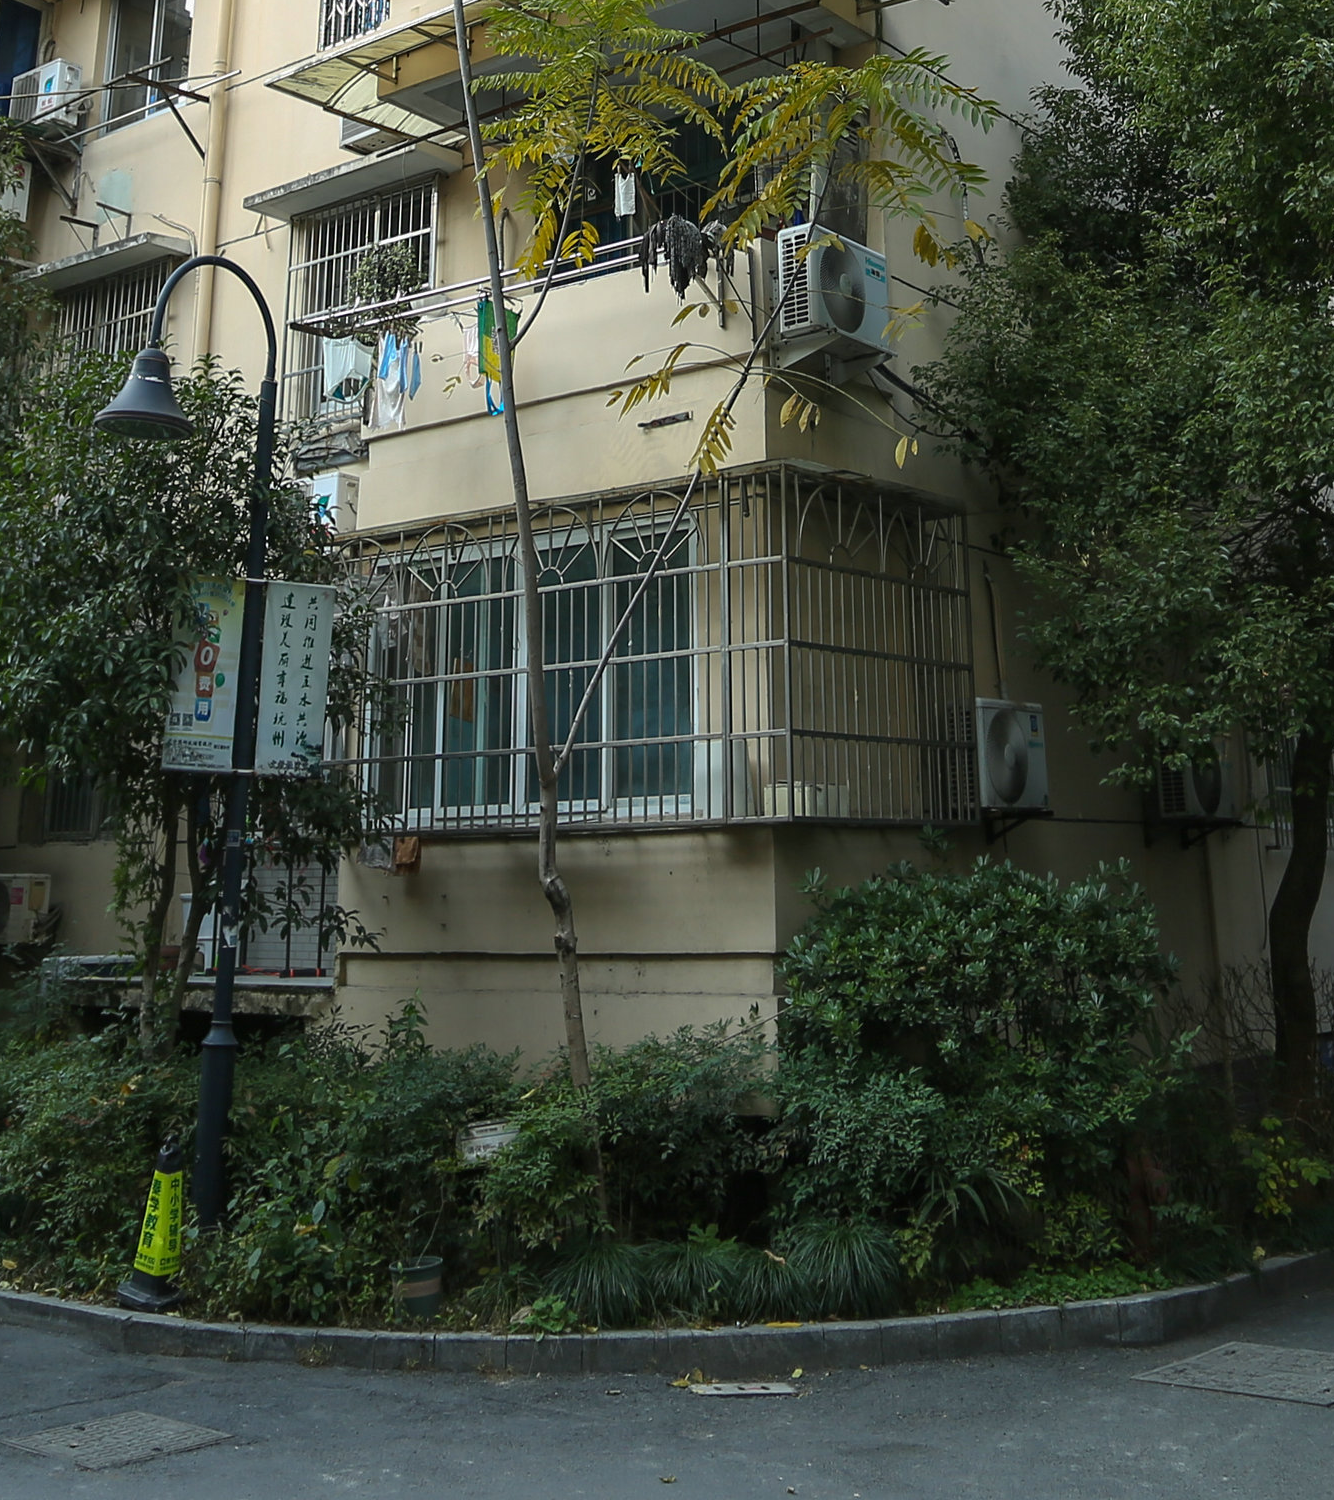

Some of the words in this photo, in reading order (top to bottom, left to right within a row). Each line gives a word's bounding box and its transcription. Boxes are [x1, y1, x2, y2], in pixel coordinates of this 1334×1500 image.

[272, 592, 296, 748] 建设美丽幸福杭州
[295, 596, 318, 747] 共同推进五水共治
